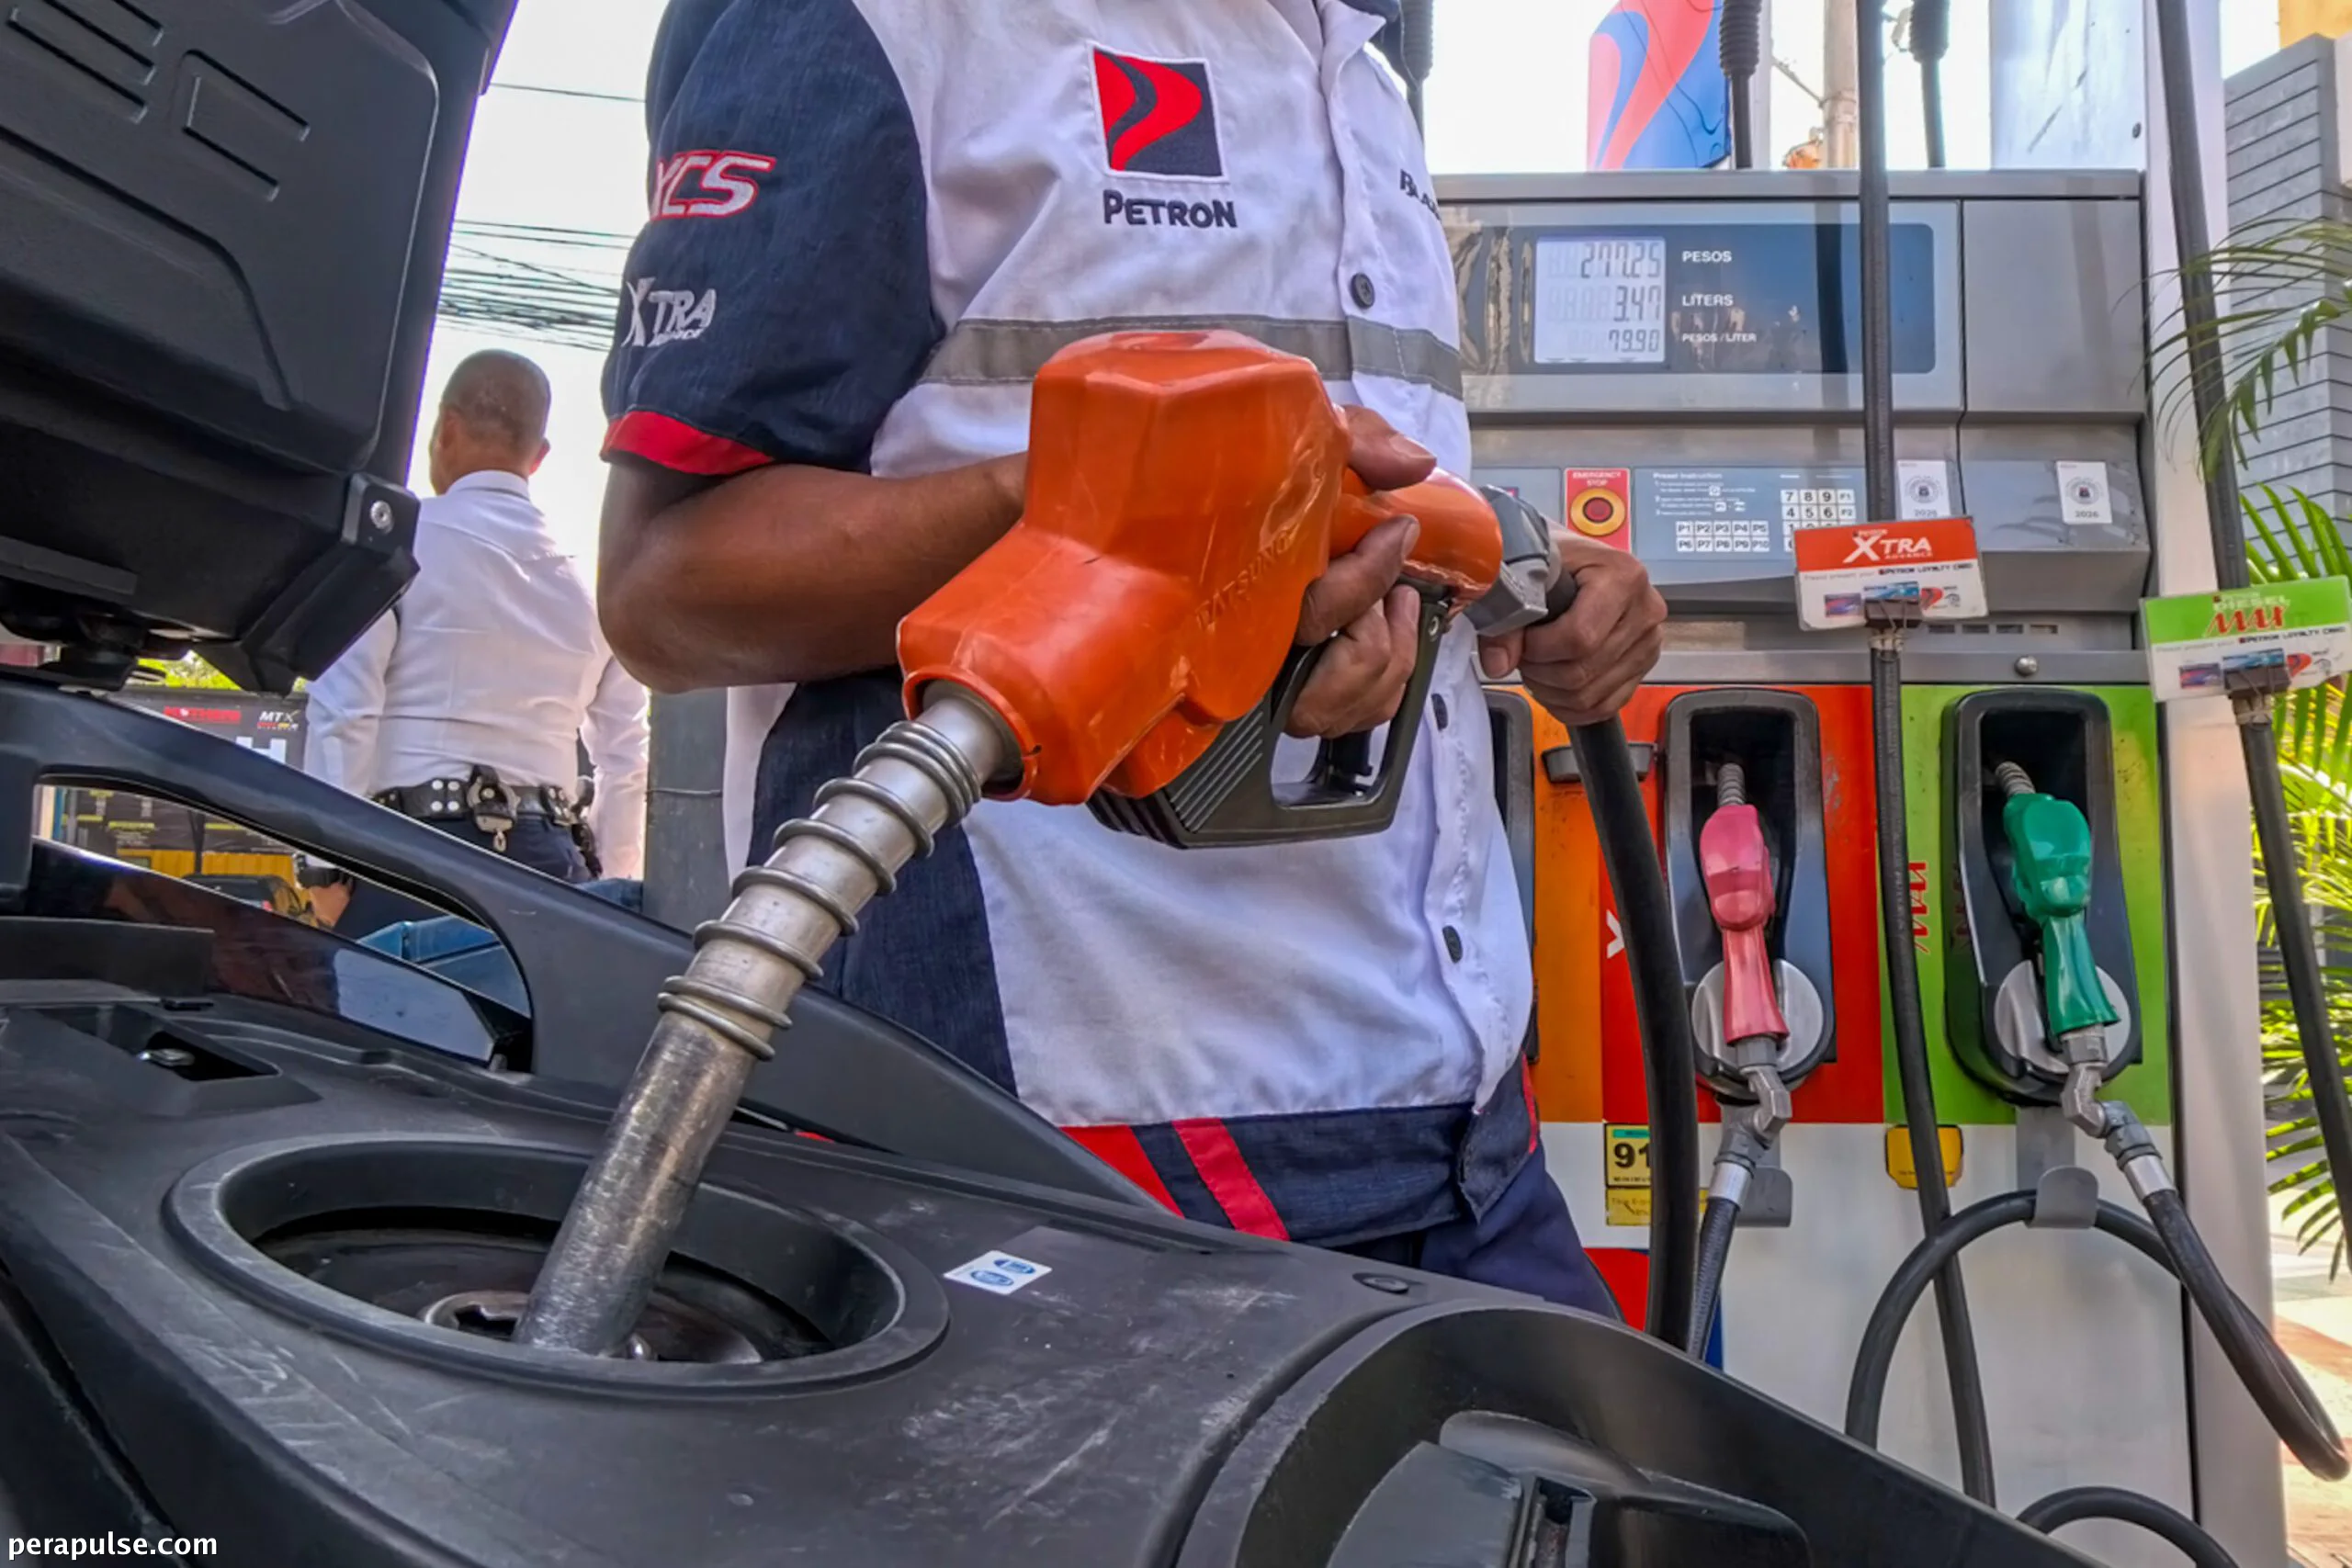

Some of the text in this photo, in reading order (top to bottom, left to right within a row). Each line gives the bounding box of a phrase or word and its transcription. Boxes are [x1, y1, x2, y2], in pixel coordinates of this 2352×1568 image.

[1103, 188, 1238, 229] PETRON
[1681, 250, 1732, 263] PESOS
[1613, 285, 1661, 321] 3.47
[1681, 293, 1734, 307] LITERS
[621, 276, 717, 347] XTRA
[1681, 333, 1718, 343] PESOS
[1726, 332, 1757, 342] LITER
[1785, 491, 1794, 502] 7
[1804, 491, 1814, 502] 8
[1822, 491, 1832, 502] 9
[1785, 507, 1795, 517] 4
[1823, 506, 1834, 519] 6
[1842, 531, 1933, 563] XTRA
[1613, 1143, 1651, 1168] 91
